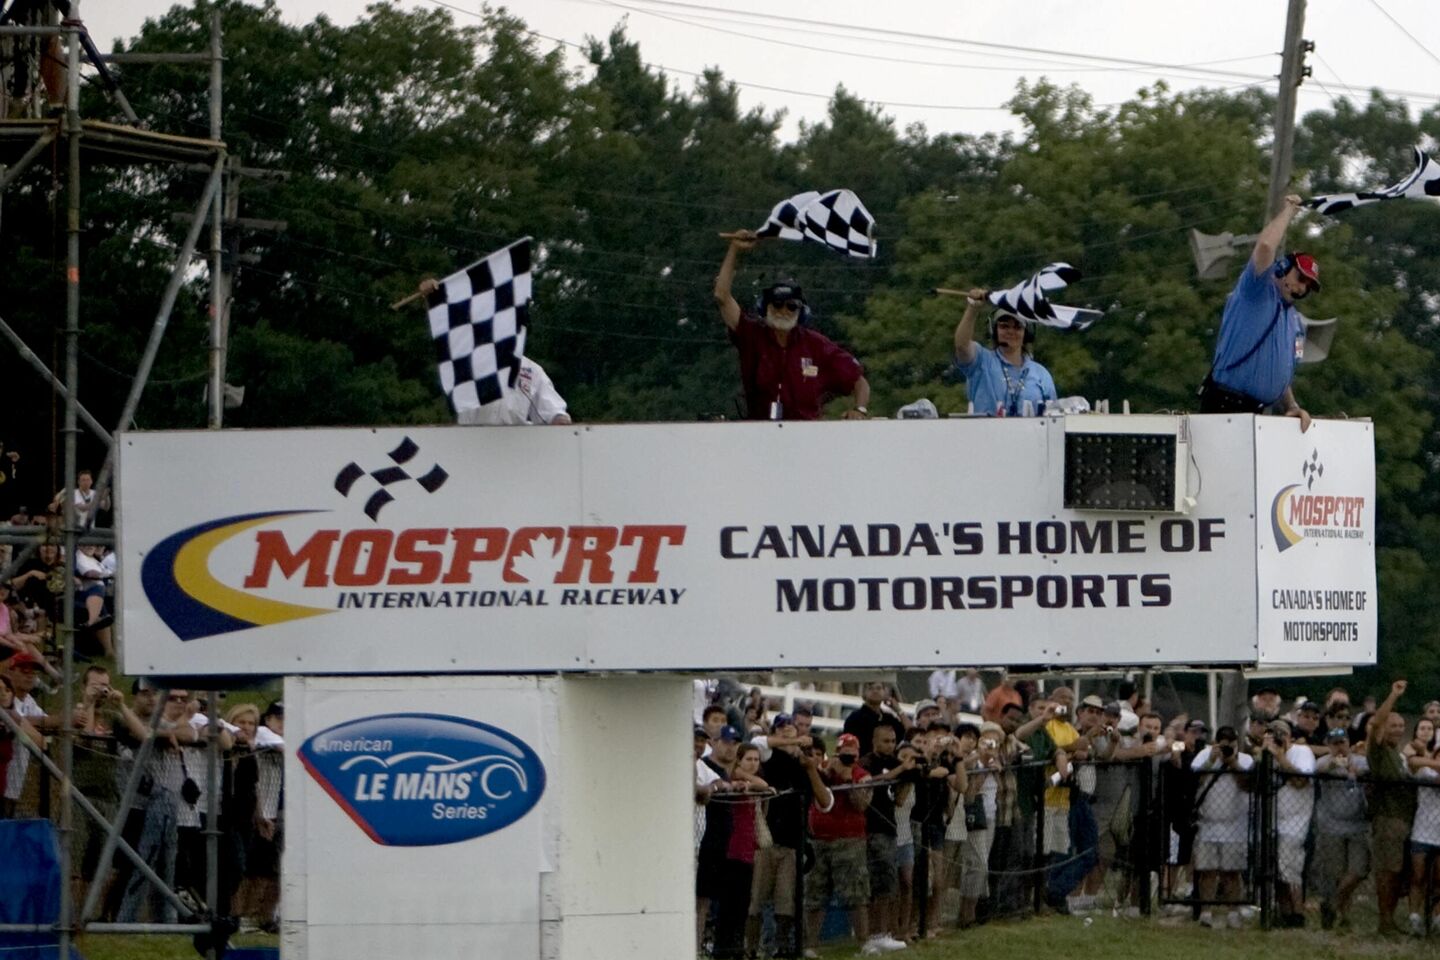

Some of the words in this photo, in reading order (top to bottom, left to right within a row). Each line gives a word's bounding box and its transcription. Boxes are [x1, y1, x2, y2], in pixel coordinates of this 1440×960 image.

[1289, 494, 1365, 528] MOSPORT
[719, 520, 984, 559] CANADA'S
[997, 518, 1146, 555] HOME
[1159, 517, 1226, 553] OF
[243, 525, 687, 588] MOSPORT
[337, 589, 549, 609] INTERNATIONAL
[560, 588, 687, 606] RACEWAY
[776, 573, 1172, 613] MOTORSPORTS
[1272, 589, 1322, 611] CANADA'S
[1324, 590, 1354, 611] HOME
[1355, 591, 1367, 611] OF
[1283, 621, 1358, 642] MOTORSPORTS
[316, 736, 393, 752] American
[354, 773, 390, 801] LE
[393, 772, 472, 801] MANS
[432, 803, 488, 820] Series
